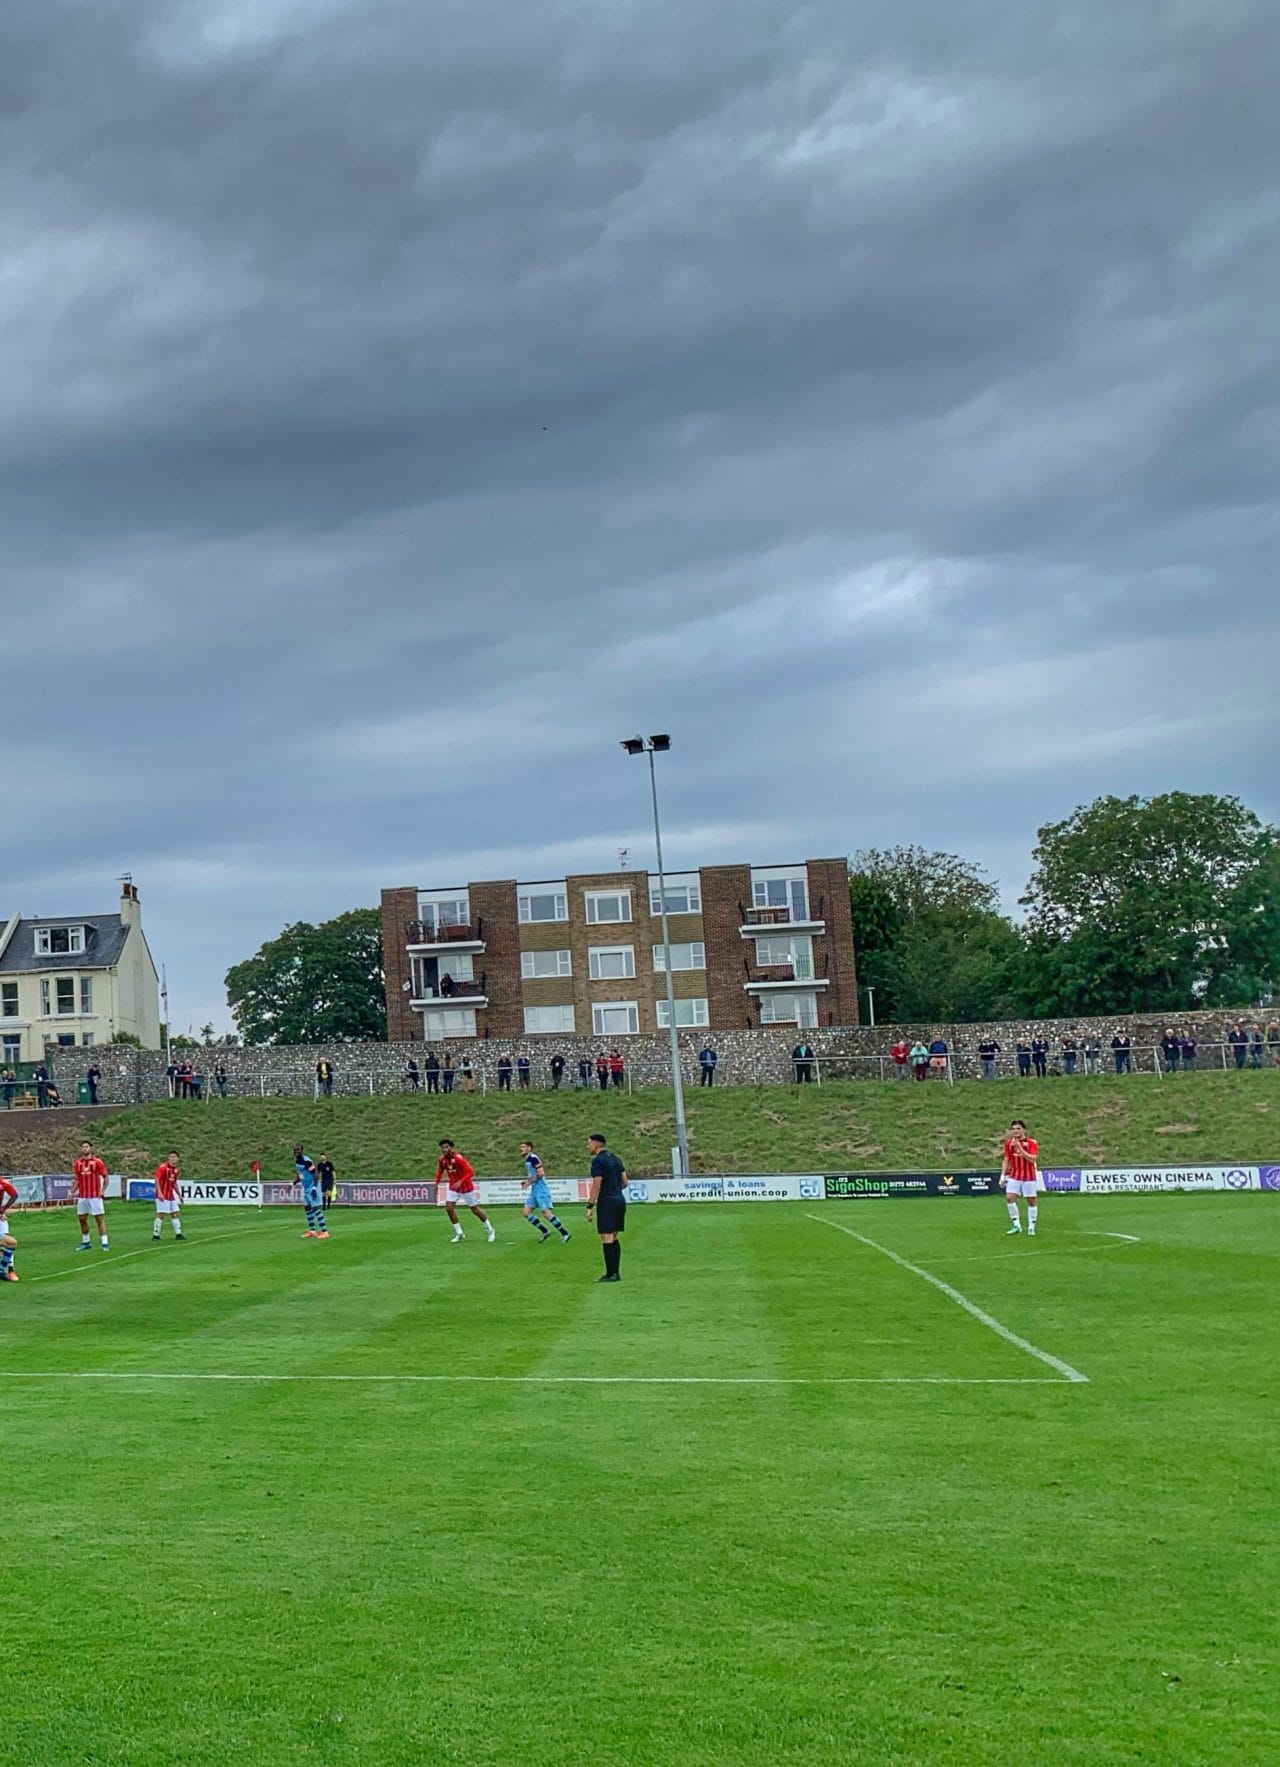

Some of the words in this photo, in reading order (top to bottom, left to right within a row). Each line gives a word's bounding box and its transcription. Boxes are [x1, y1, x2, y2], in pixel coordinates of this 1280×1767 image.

[1133, 1173, 1162, 1183] OWN
[1165, 1172, 1214, 1182] CINEMA
[684, 1181, 722, 1190] savings
[738, 1180, 766, 1188] loans
[826, 1178, 889, 1193] SignShop
[181, 1185, 259, 1199] HARVEYS
[353, 1188, 429, 1200] HOMOPHOBIA
[659, 1189, 788, 1199] www.credit-union.coop
